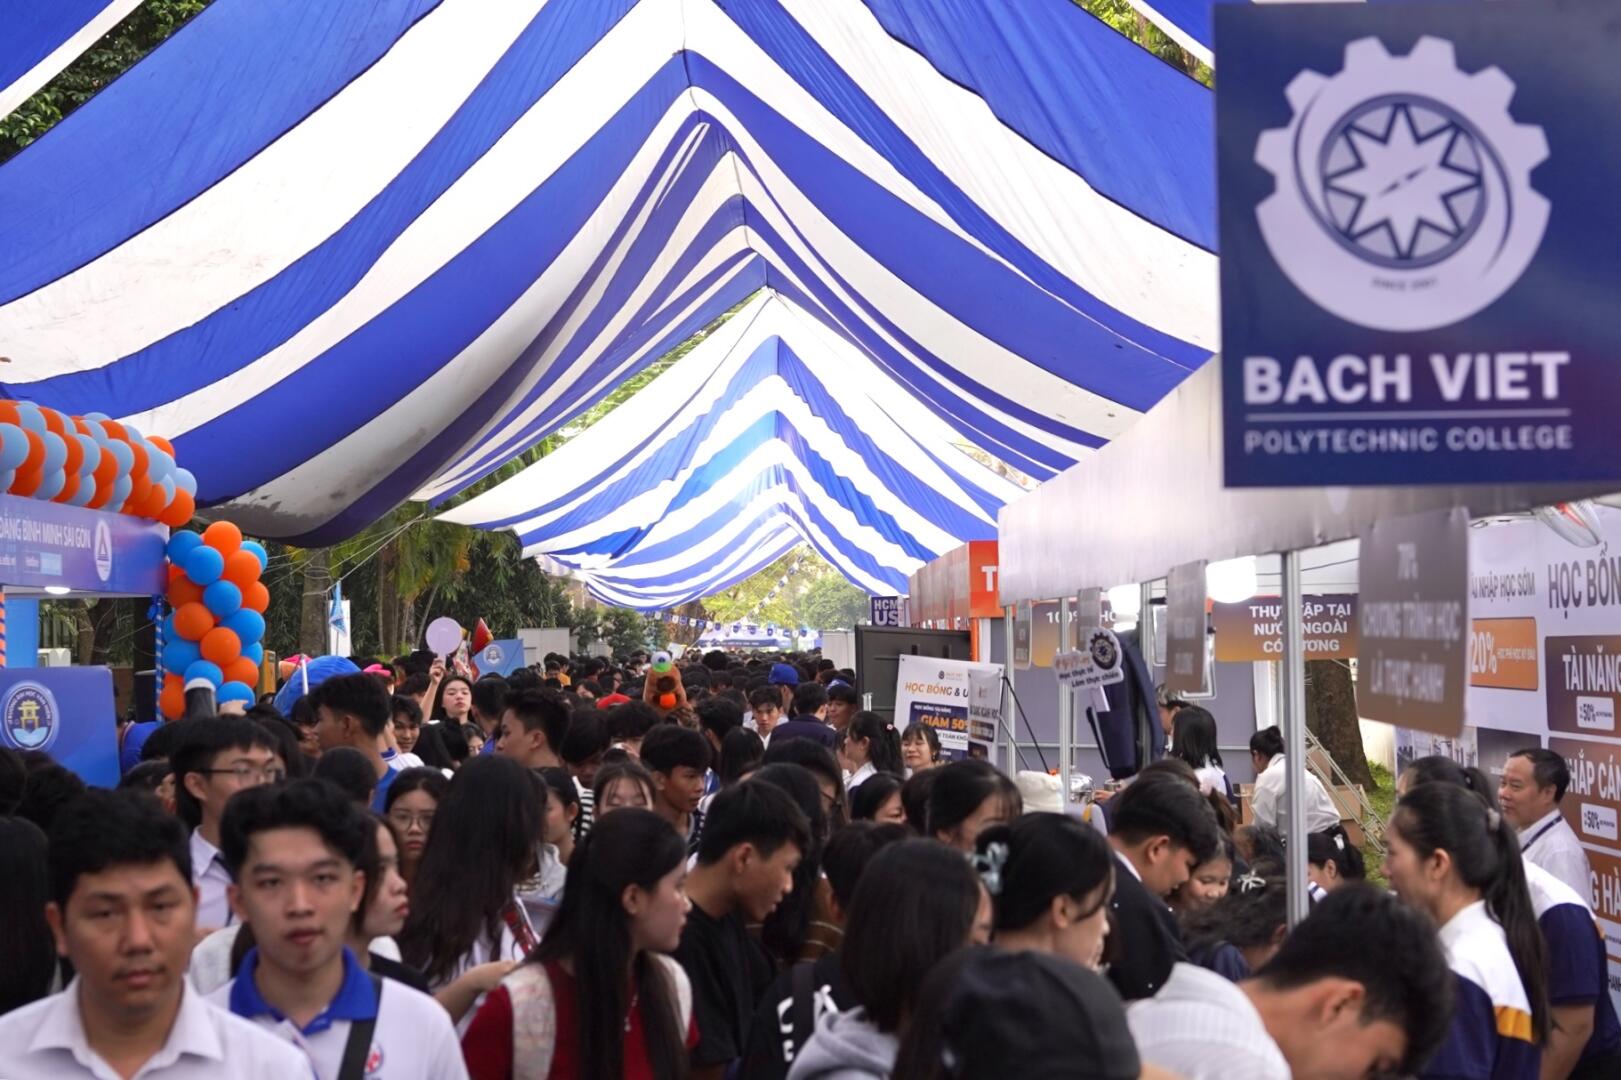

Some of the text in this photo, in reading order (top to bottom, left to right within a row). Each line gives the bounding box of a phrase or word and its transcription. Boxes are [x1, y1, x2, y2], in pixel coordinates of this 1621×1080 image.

[1244, 352, 1571, 405] BACH VIET
[1244, 424, 1573, 454] POLYTECHNIC COLLEGE
[42, 521, 63, 546] MINH
[1500, 573, 1516, 603] HỌC
[1548, 560, 1582, 620] HỌC
[874, 610, 899, 626] US
[1249, 602, 1351, 620] THỰ ẬP TẠI
[1301, 619, 1348, 635] NGOÀI
[1263, 638, 1284, 653] CÓ
[1471, 631, 1498, 675] 20%
[1562, 644, 1584, 691] TÀI
[905, 682, 924, 695] HỌC
[954, 687, 960, 697] &
[920, 712, 949, 729] GIẢM
